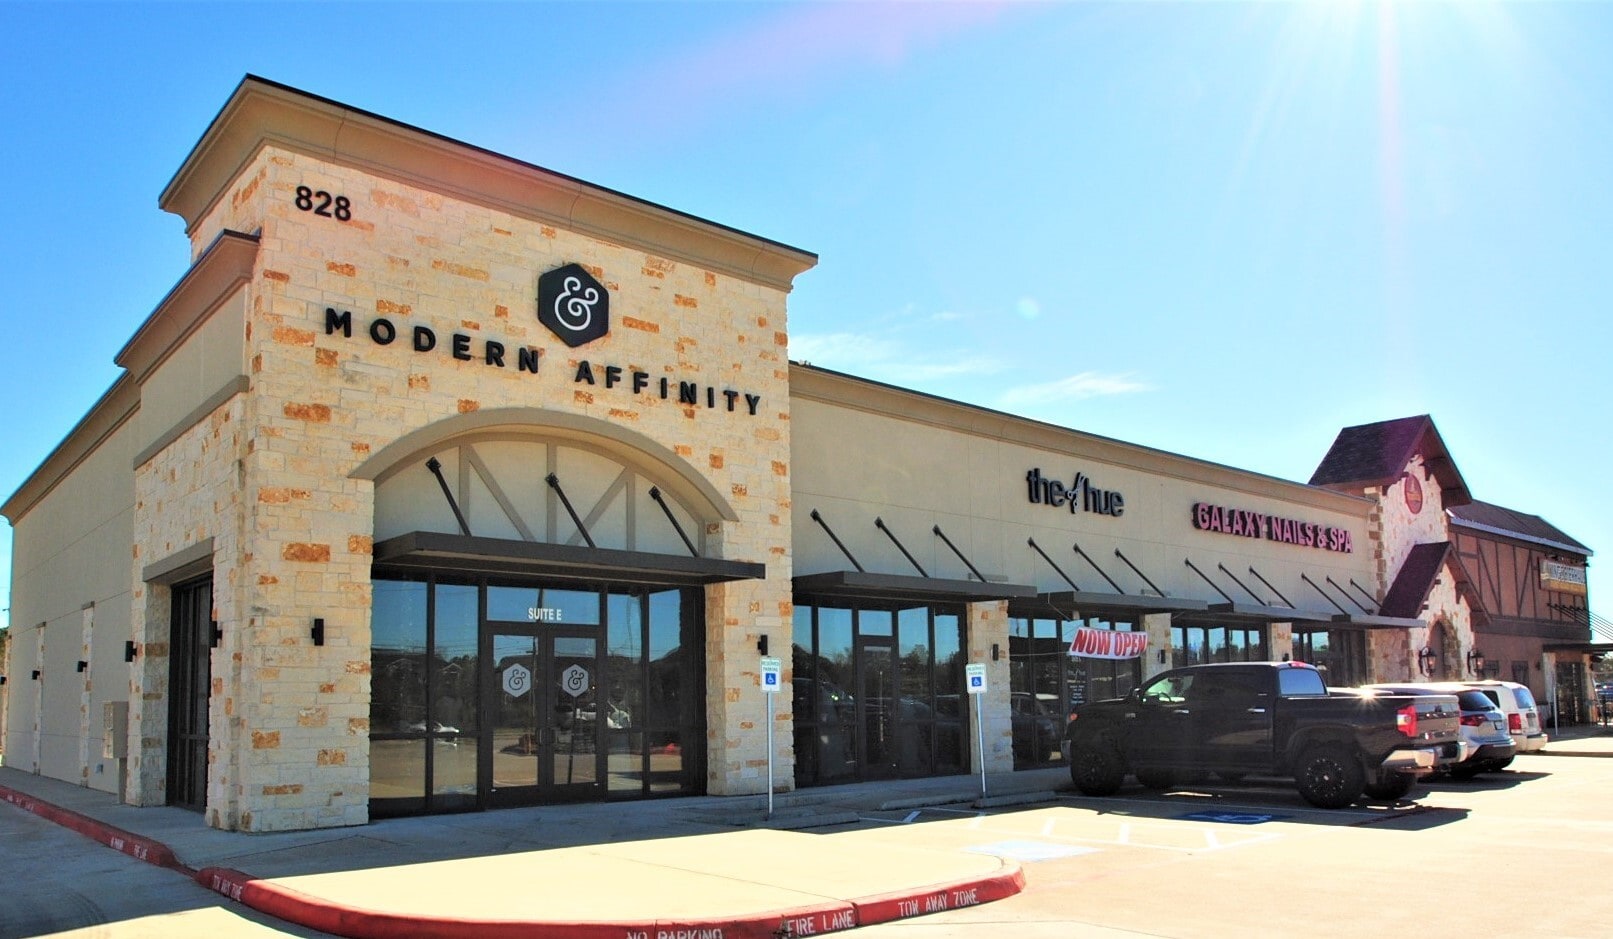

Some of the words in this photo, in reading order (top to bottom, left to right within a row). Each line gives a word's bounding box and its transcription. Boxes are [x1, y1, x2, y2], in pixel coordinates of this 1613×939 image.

[295, 186, 352, 222] 828
[554, 276, 600, 331] &
[325, 307, 540, 375] MODERN
[575, 360, 761, 416] AFFINITY
[1026, 468, 1065, 507] the
[1083, 477, 1125, 517] hue
[1193, 502, 1267, 539] GALAXY
[1267, 515, 1314, 547] NAILS
[1316, 524, 1328, 549] &
[1327, 527, 1353, 553] SPA
[528, 607, 554, 620] SUITE
[556, 609, 562, 620] E
[1071, 629, 1112, 656] NOW
[1113, 631, 1147, 657] OPEN
[898, 902, 919, 917] TOW
[925, 895, 948, 913] AWAY
[953, 888, 979, 907] ZONE
[786, 917, 816, 938] FIRE
[822, 909, 856, 931] LANE
